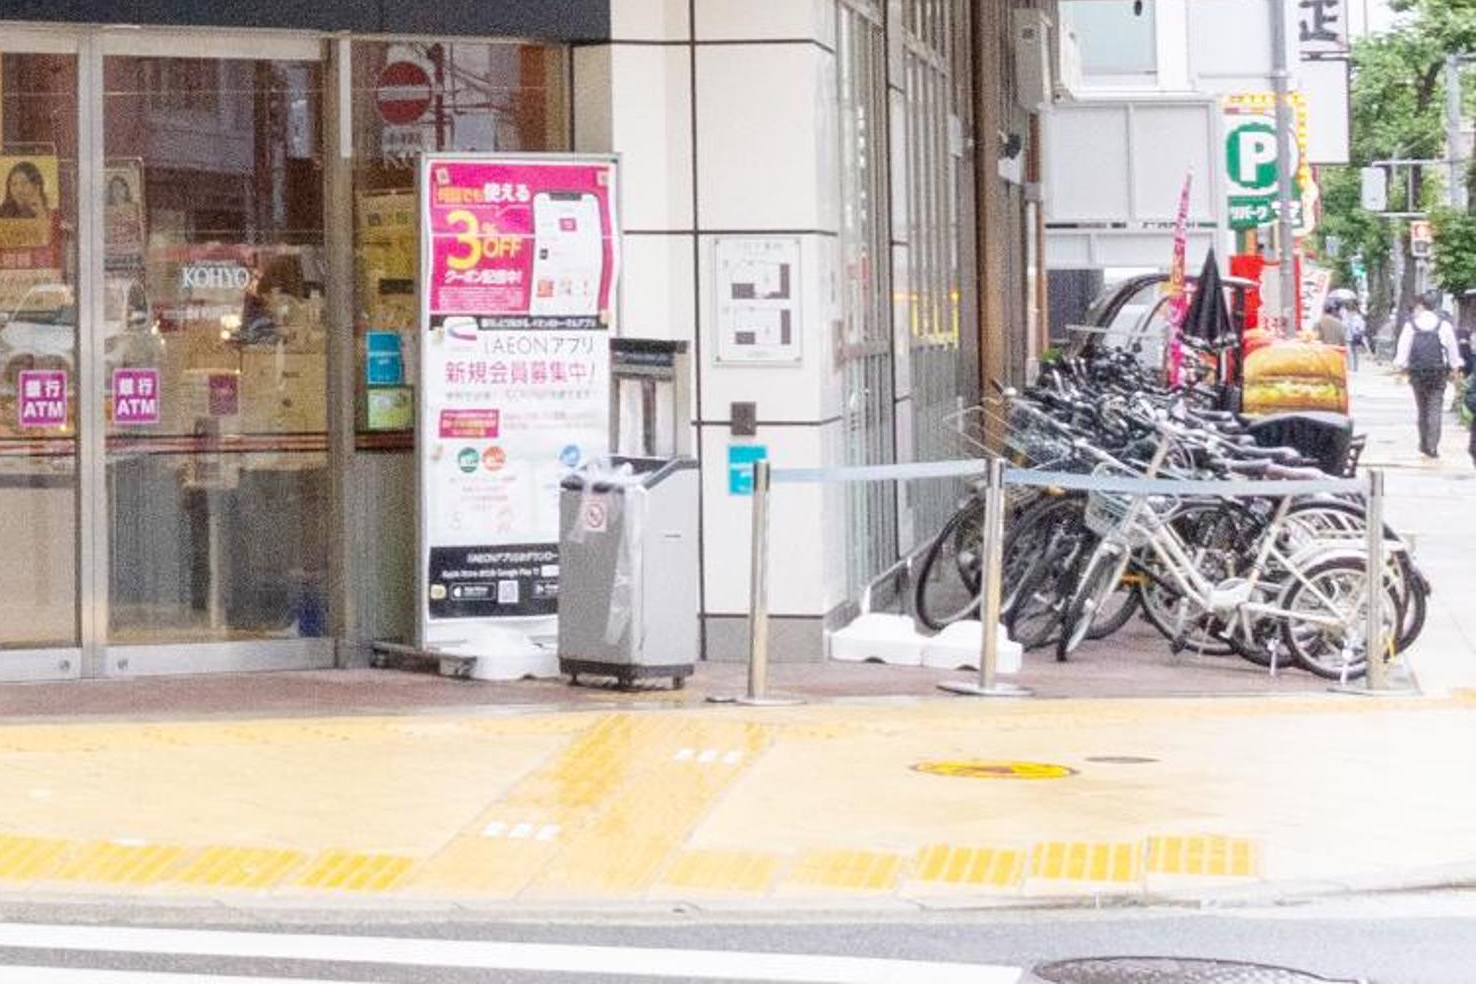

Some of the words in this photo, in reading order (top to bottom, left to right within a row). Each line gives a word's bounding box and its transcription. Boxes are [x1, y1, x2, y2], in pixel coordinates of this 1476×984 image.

[1238, 130, 1278, 183] P
[182, 267, 250, 289] KOHYO
[24, 401, 64, 418] ATM
[117, 399, 156, 416] ATM
